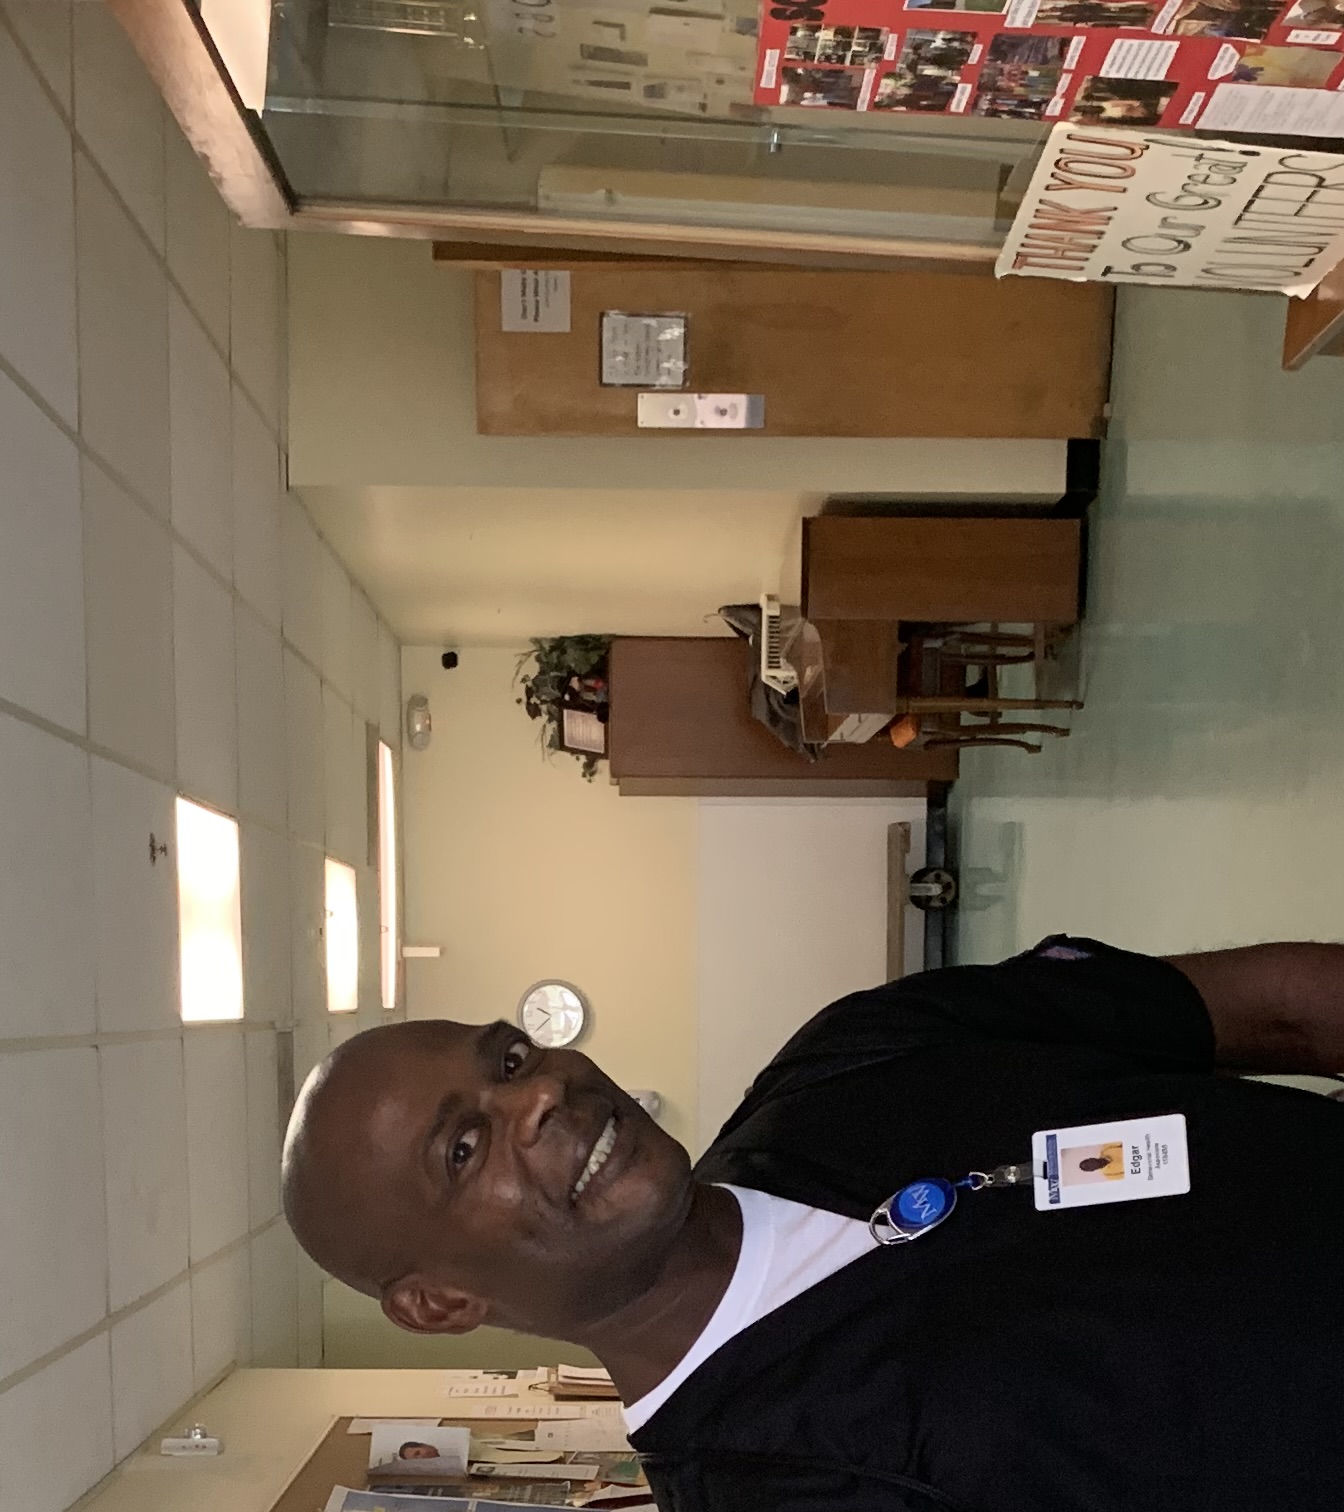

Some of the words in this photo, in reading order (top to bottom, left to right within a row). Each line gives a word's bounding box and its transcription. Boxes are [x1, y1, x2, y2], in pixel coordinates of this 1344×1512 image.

[1043, 133, 1150, 194] YOU
[1011, 198, 1118, 272] THANK
[1121, 214, 1207, 256] Our
[1100, 261, 1178, 278] To
[1130, 1145, 1143, 1175] Edgar
